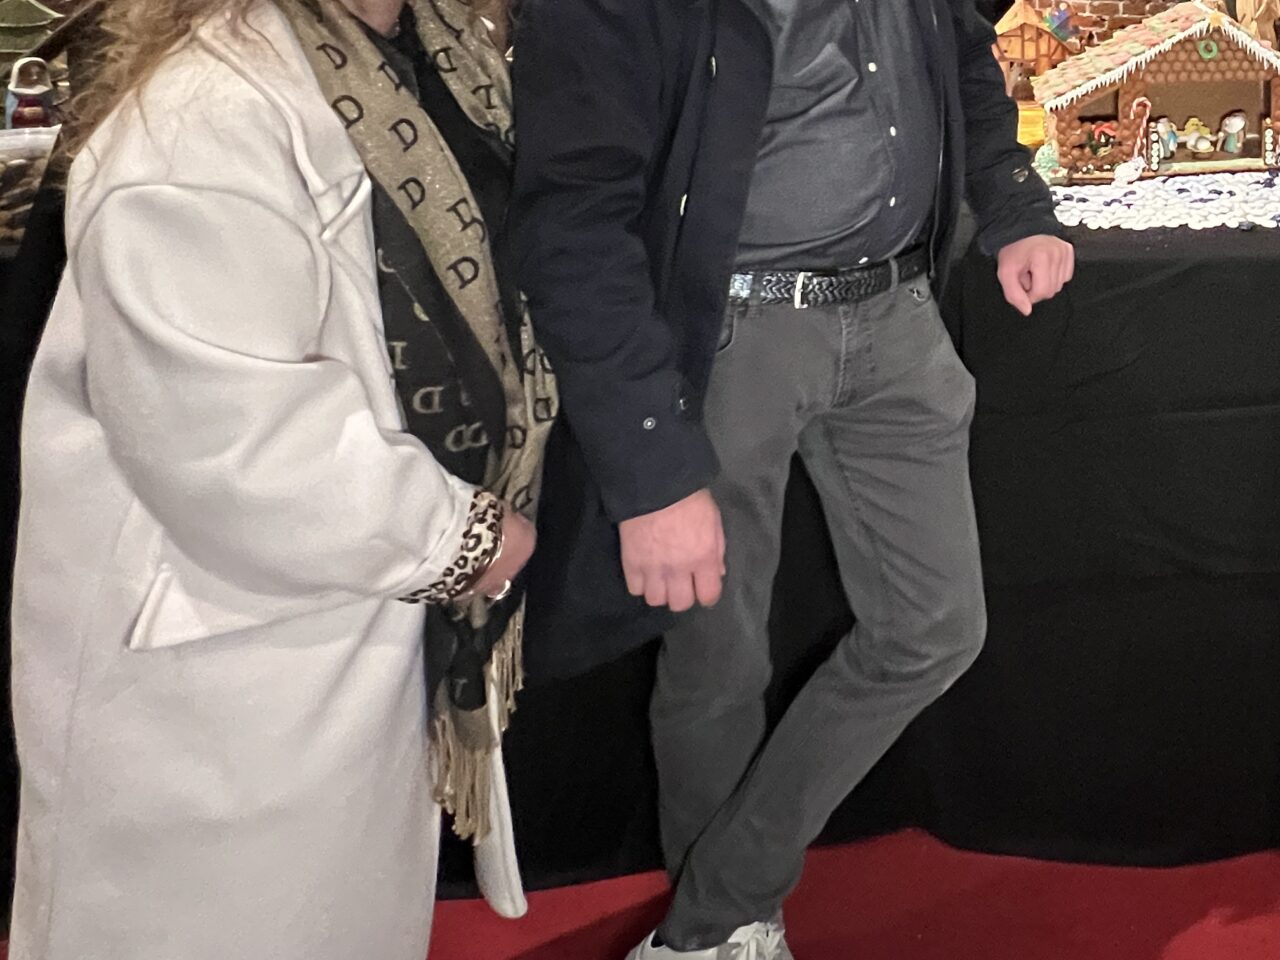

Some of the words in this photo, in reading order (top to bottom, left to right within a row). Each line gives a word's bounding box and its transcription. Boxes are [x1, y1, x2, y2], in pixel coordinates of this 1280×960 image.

[316, 43, 348, 70] D
[331, 95, 364, 129] D
[387, 118, 419, 152] D
[397, 177, 426, 210] D
[447, 256, 480, 289] D
